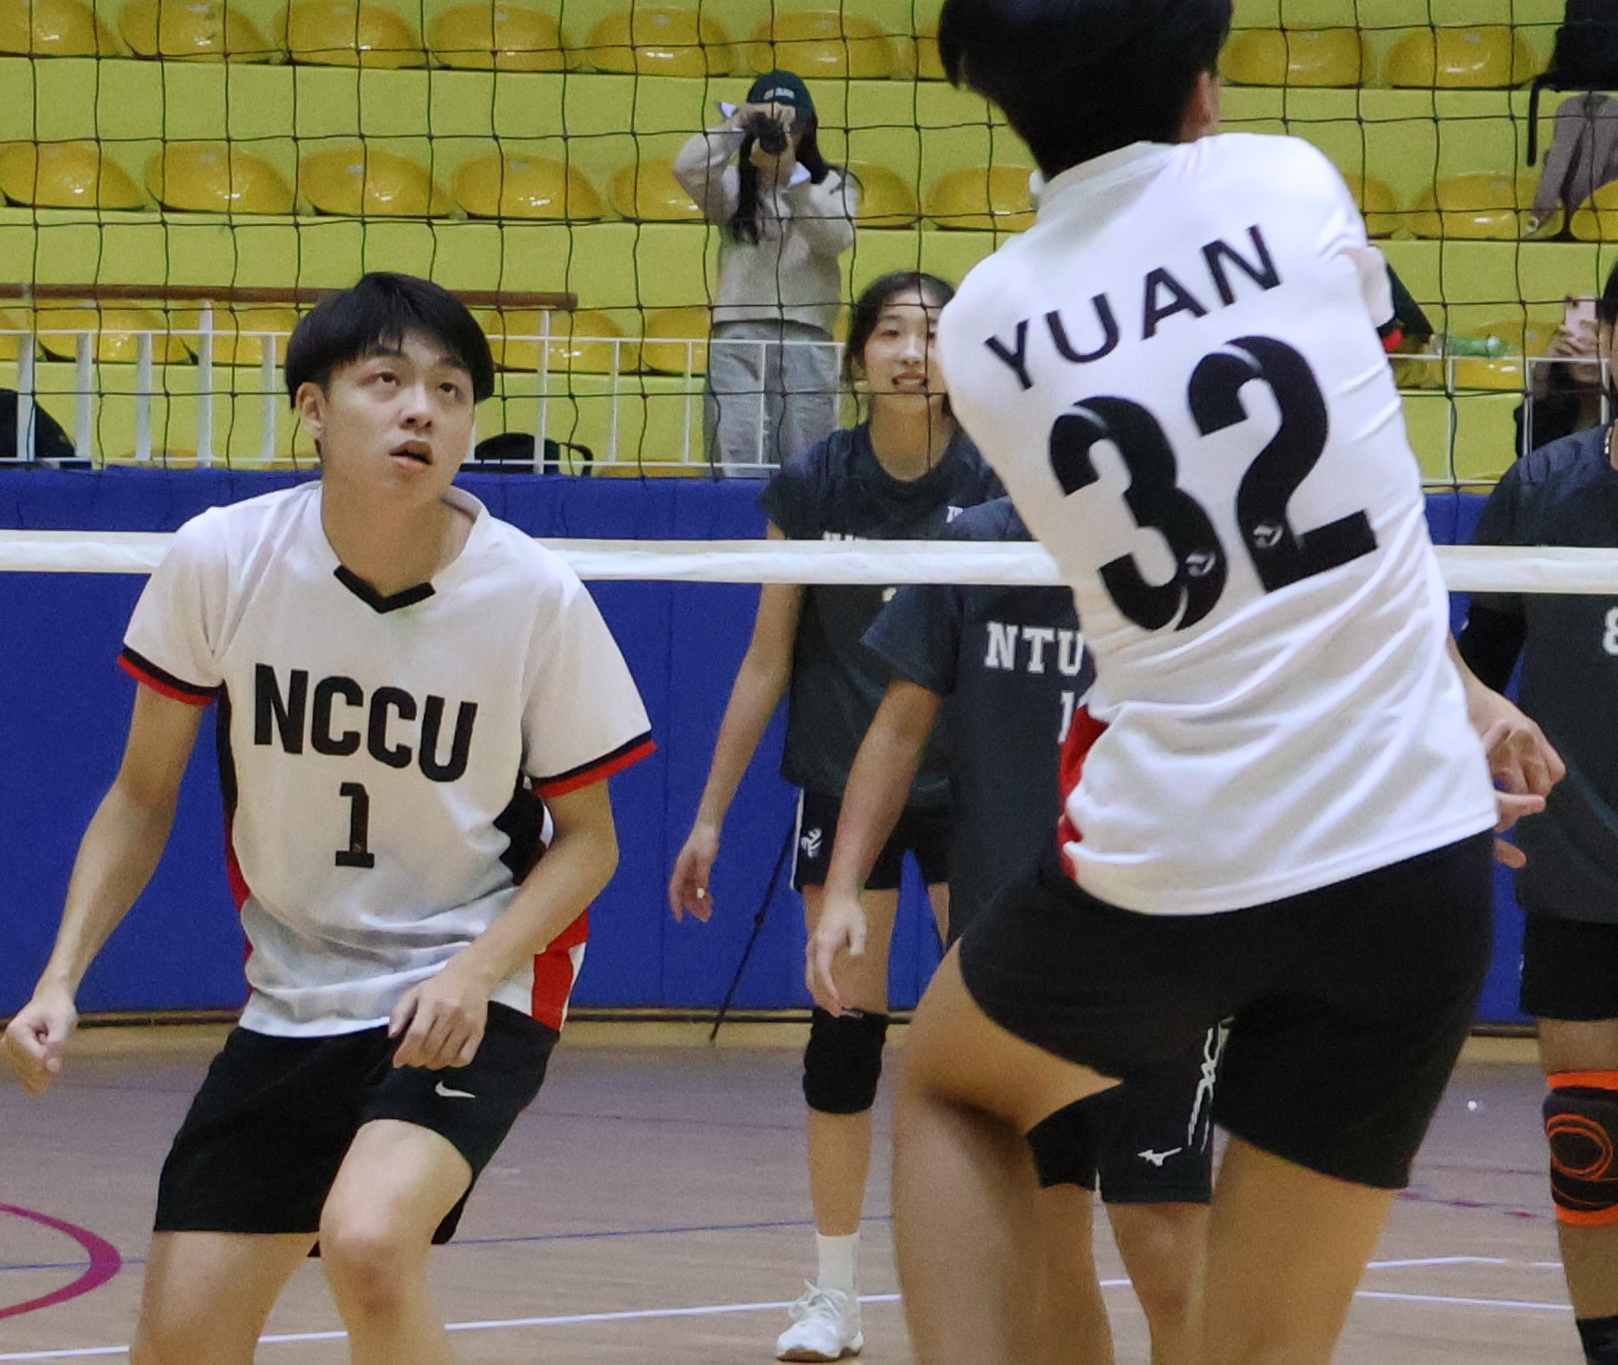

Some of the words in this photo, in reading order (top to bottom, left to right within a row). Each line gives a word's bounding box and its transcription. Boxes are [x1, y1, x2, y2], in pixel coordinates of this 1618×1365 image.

[984, 224, 1280, 391] YUAN
[1049, 335, 1378, 632] 32
[984, 619, 1085, 677] NTU
[253, 663, 479, 783] NCCU
[334, 781, 376, 869] 1
